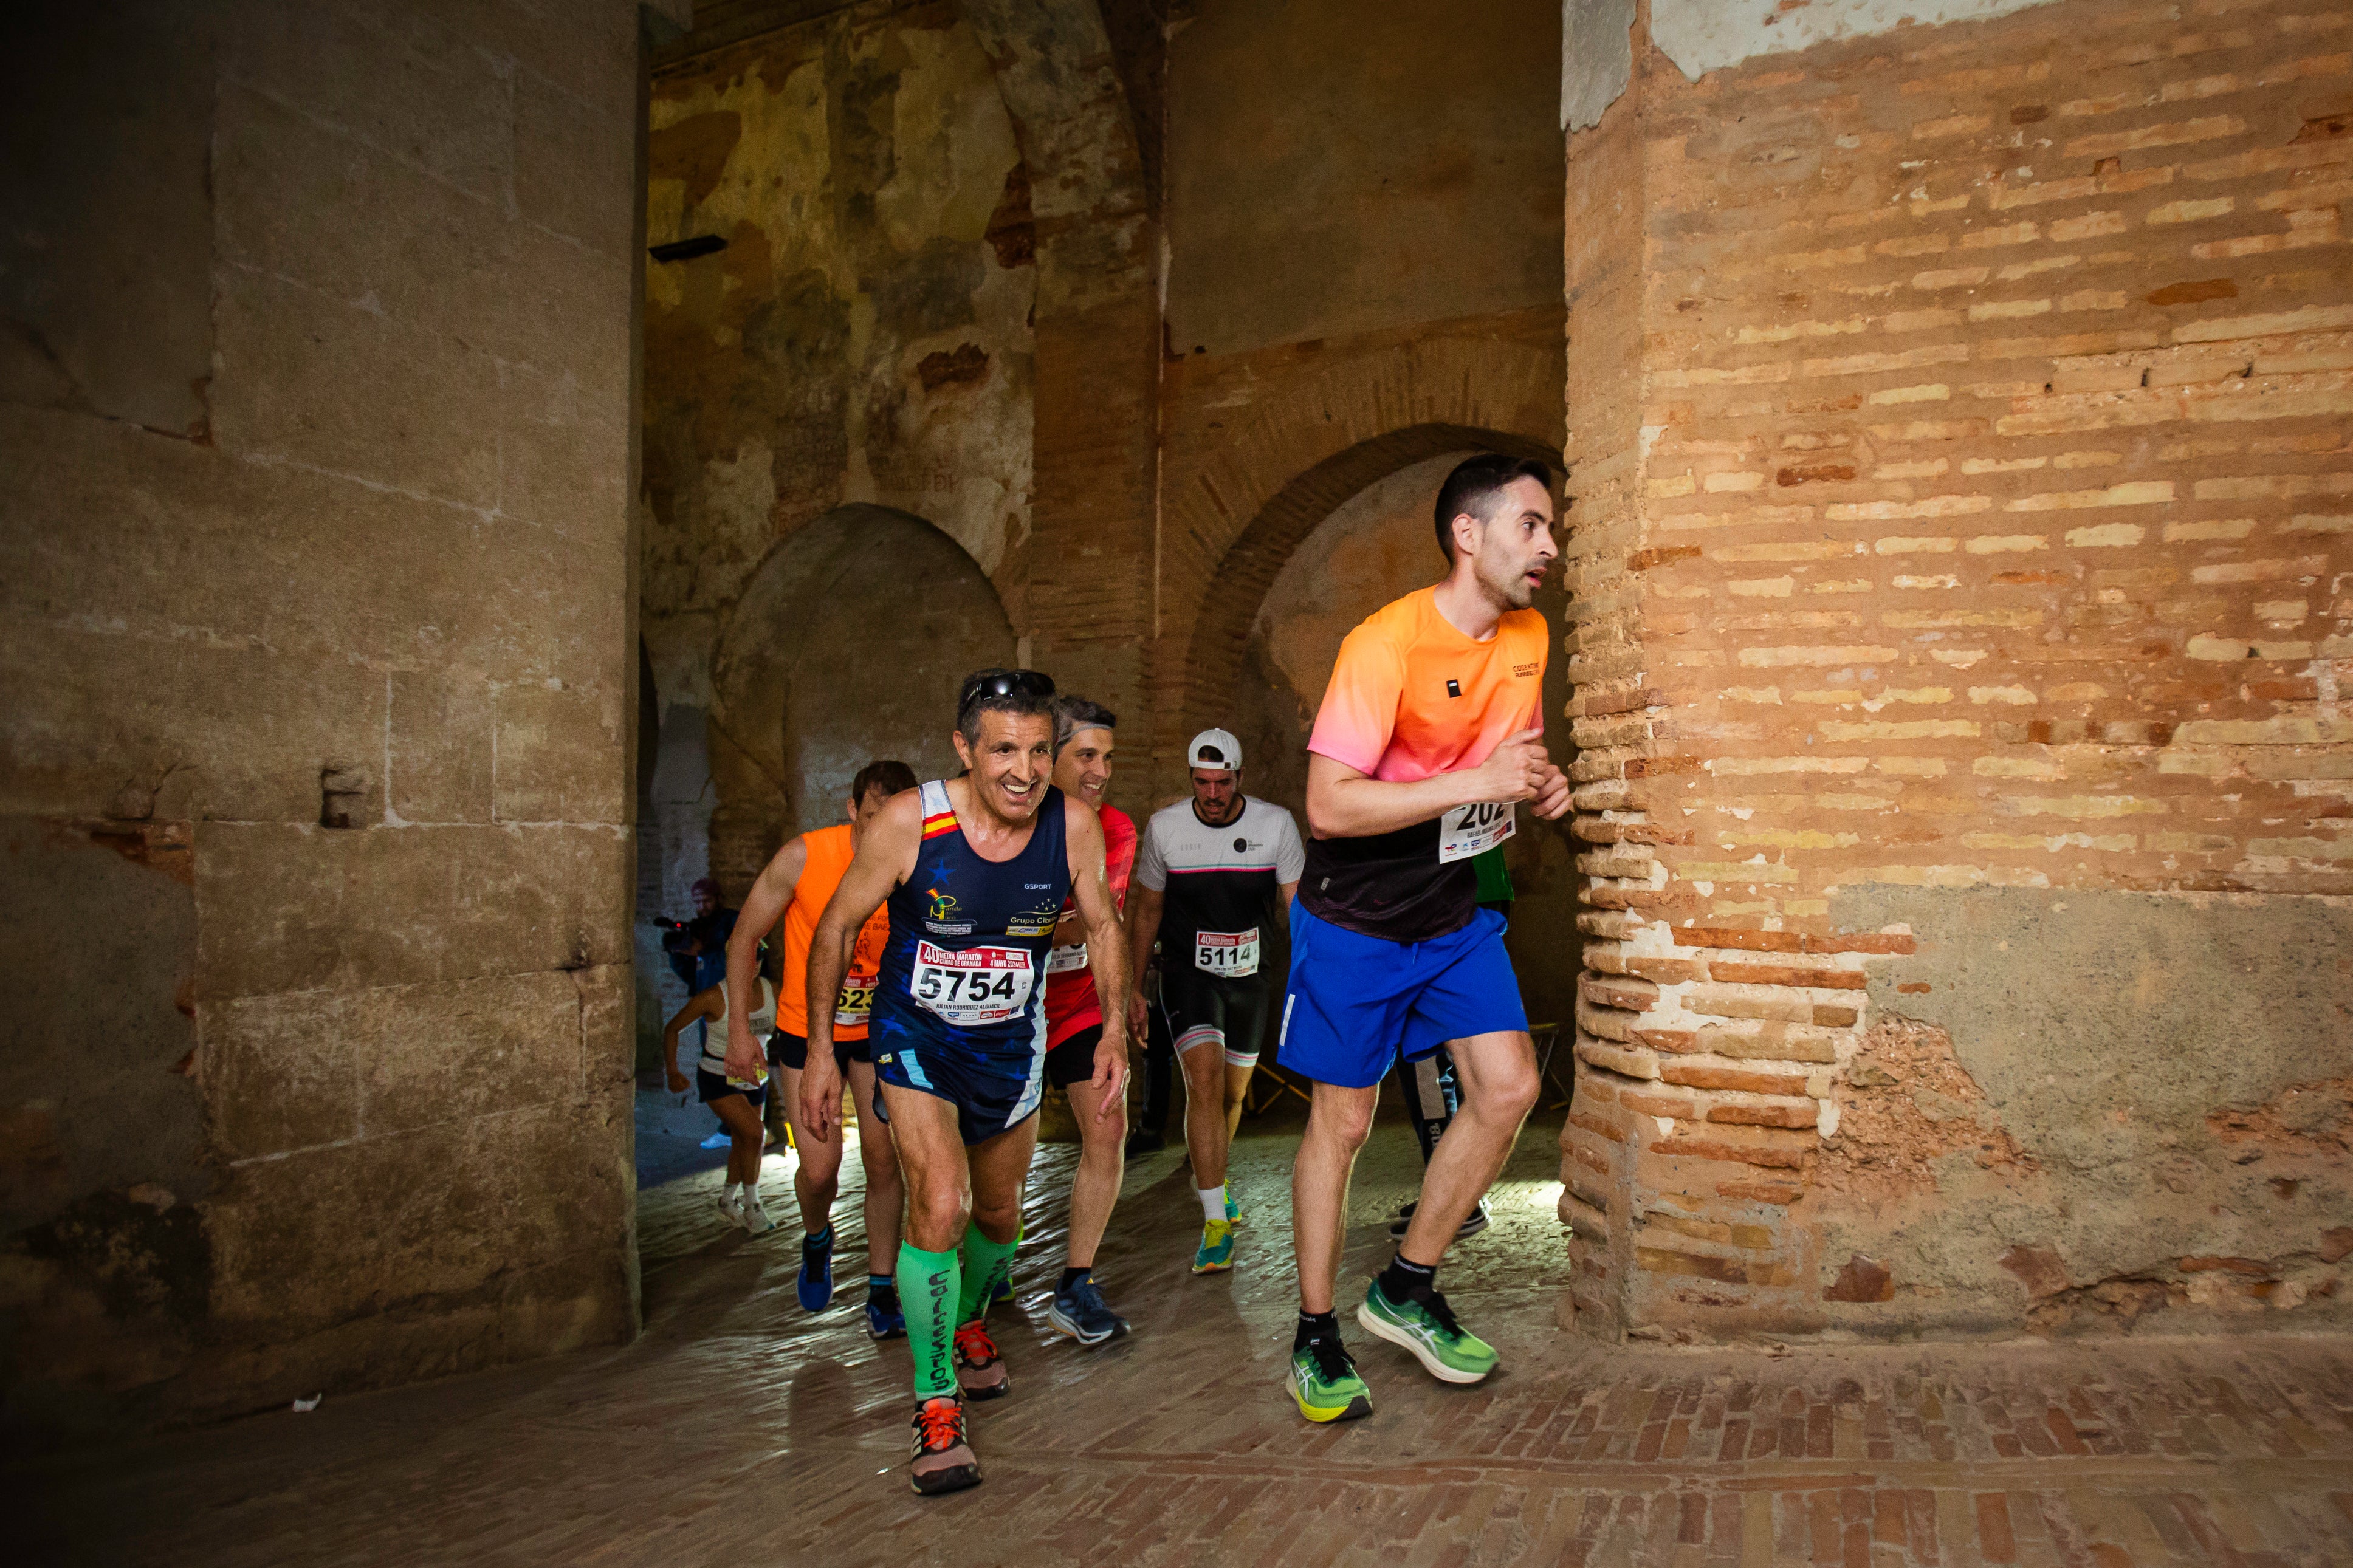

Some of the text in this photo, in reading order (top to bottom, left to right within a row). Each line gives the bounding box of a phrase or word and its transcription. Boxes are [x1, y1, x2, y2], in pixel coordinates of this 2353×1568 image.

[1201, 934, 1211, 945] 40
[924, 947, 939, 964] 40
[939, 952, 955, 960] MEDIA
[956, 952, 983, 961] MARATÓN
[1200, 944, 1251, 966] 5114
[918, 967, 1015, 1002] 5754
